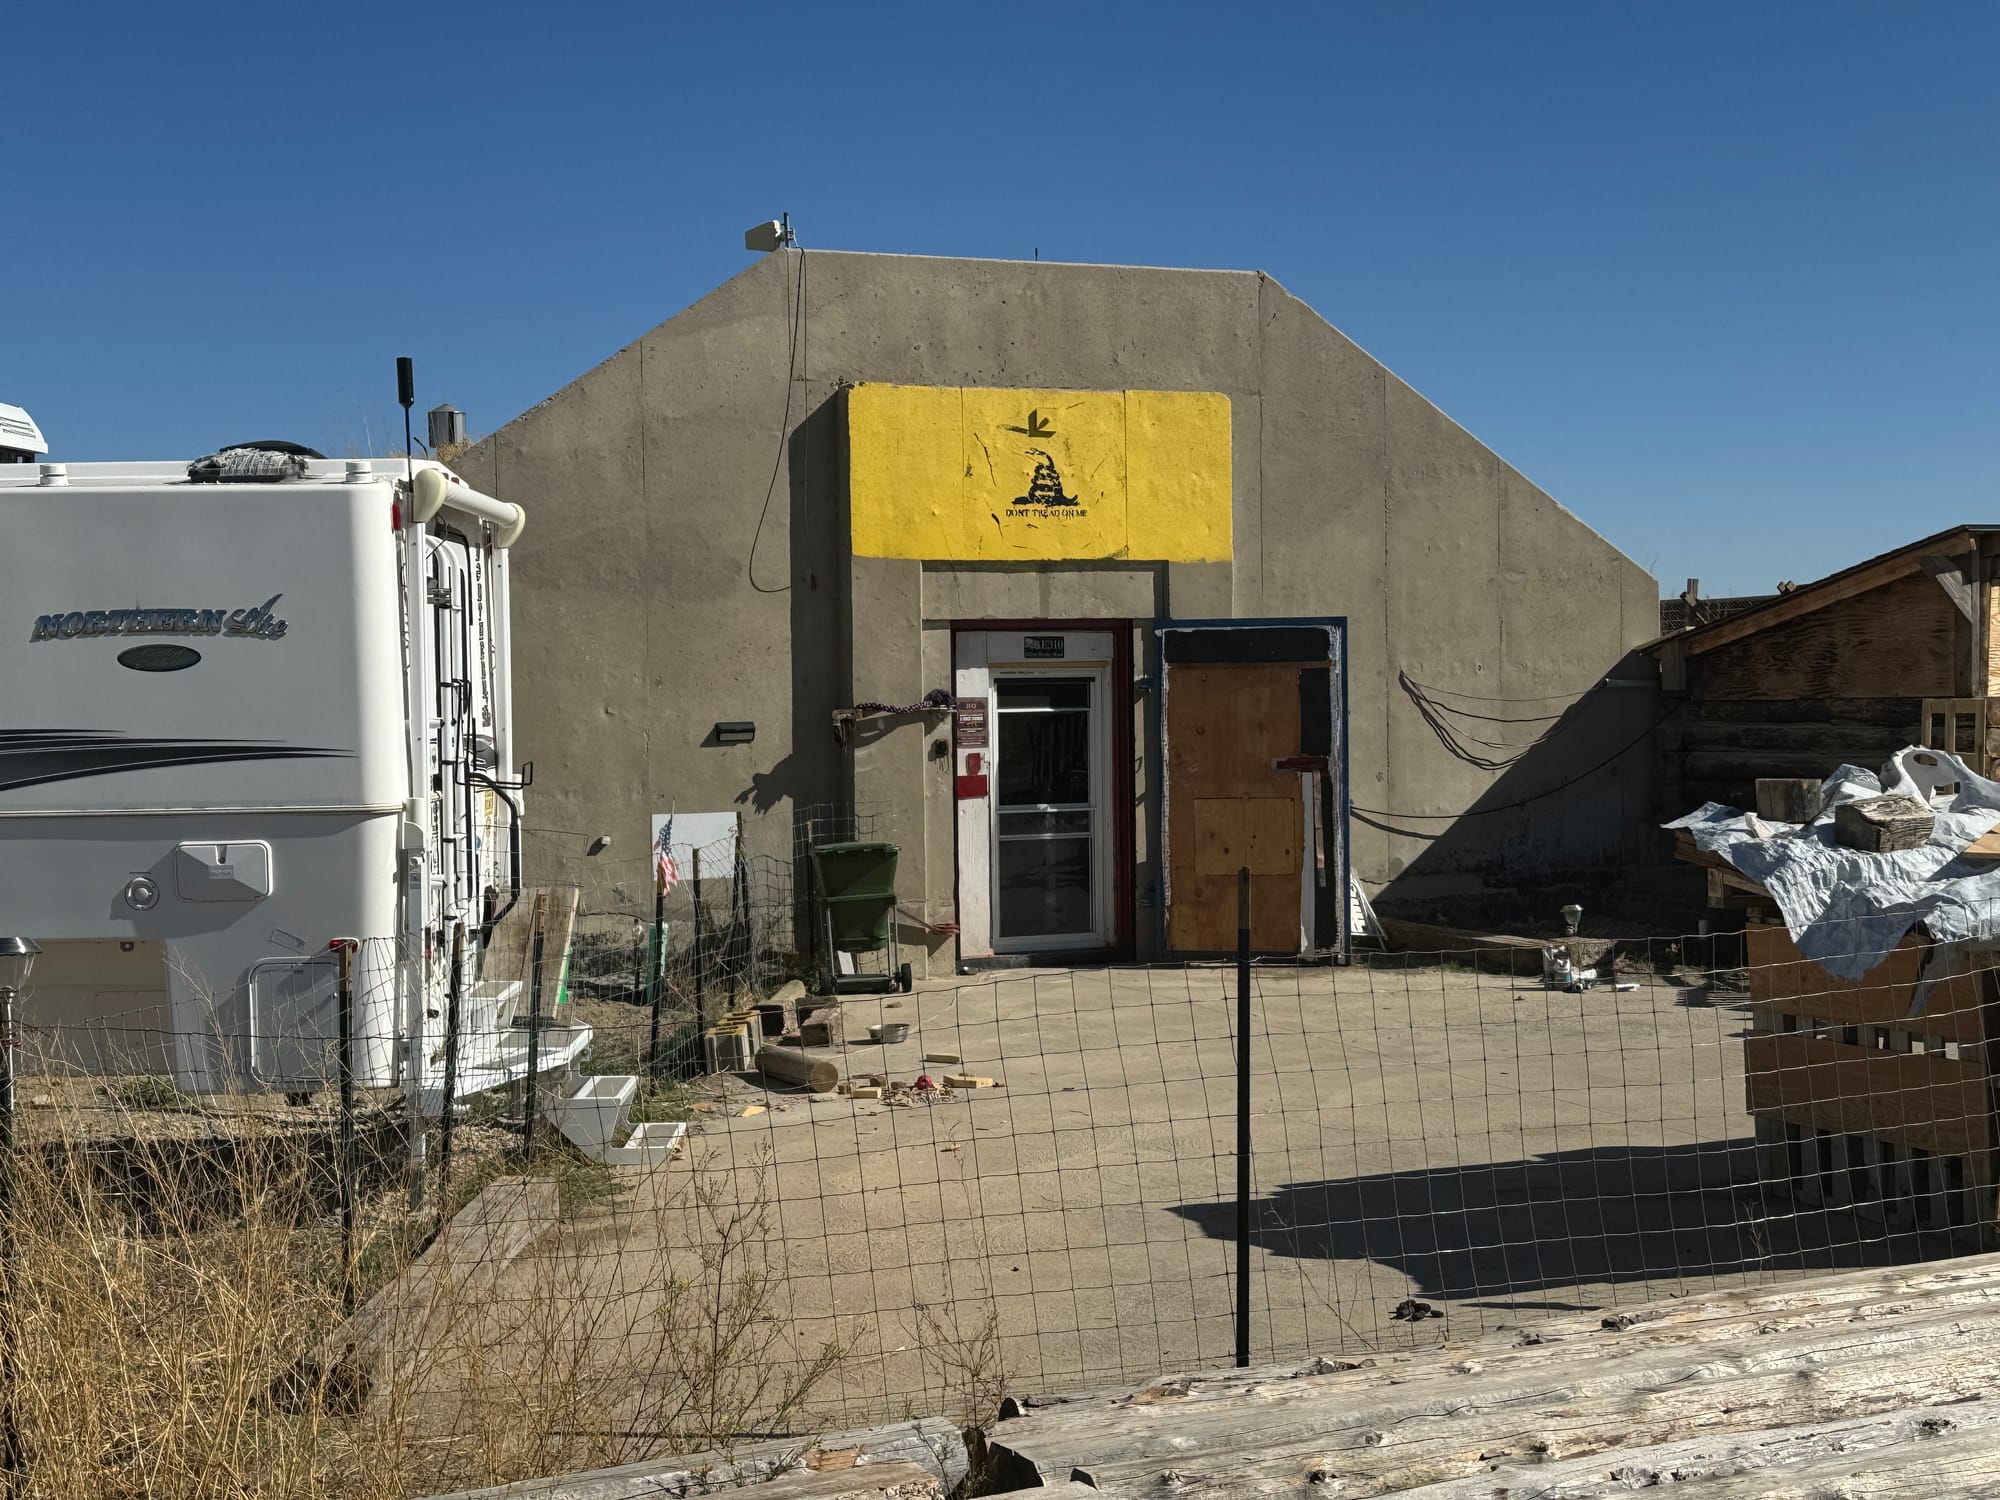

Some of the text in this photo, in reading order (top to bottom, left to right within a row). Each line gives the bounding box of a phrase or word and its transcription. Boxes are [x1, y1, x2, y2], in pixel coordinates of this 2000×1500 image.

[1032, 509, 1060, 519] TREAD
[1062, 509, 1075, 518] ON
[1075, 509, 1088, 517] ME
[30, 608, 227, 642] NORTHERN
